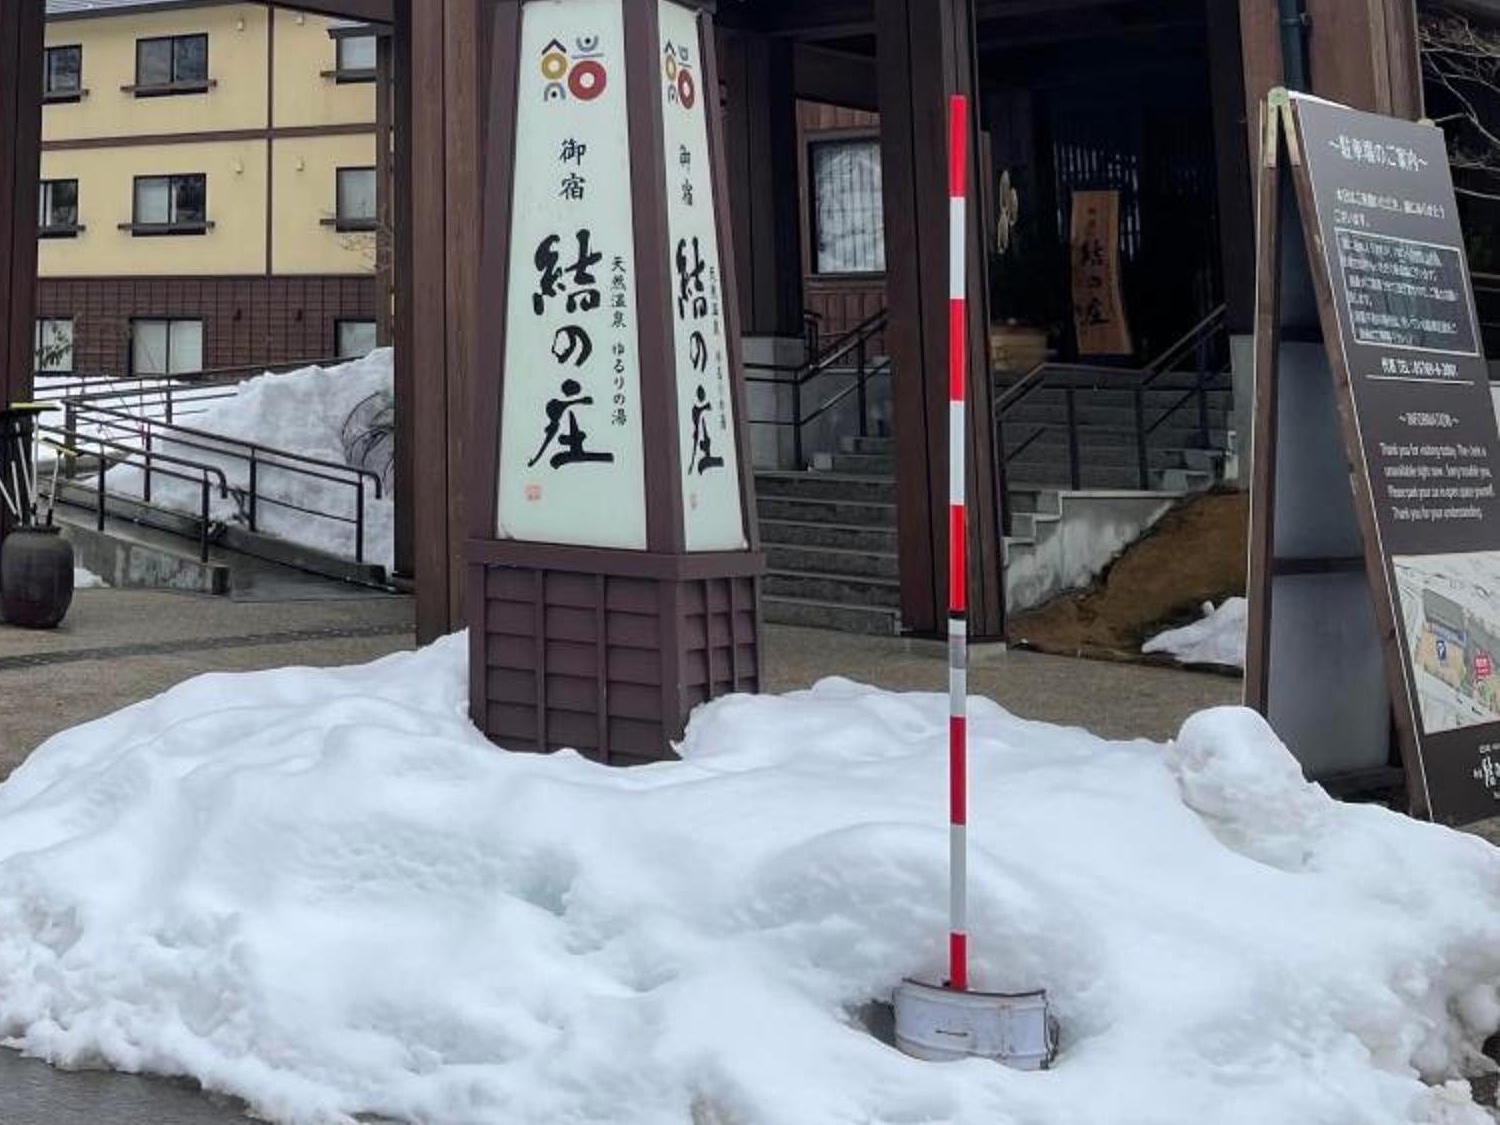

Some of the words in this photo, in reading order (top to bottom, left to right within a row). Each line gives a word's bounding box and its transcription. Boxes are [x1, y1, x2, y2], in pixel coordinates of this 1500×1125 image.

[559, 138, 587, 201] 御宿
[611, 255, 627, 328] 天然温泉
[526, 228, 614, 470] 結の庄
[612, 341, 627, 426] ゆるりの湯
[675, 235, 725, 475] 結の庄
